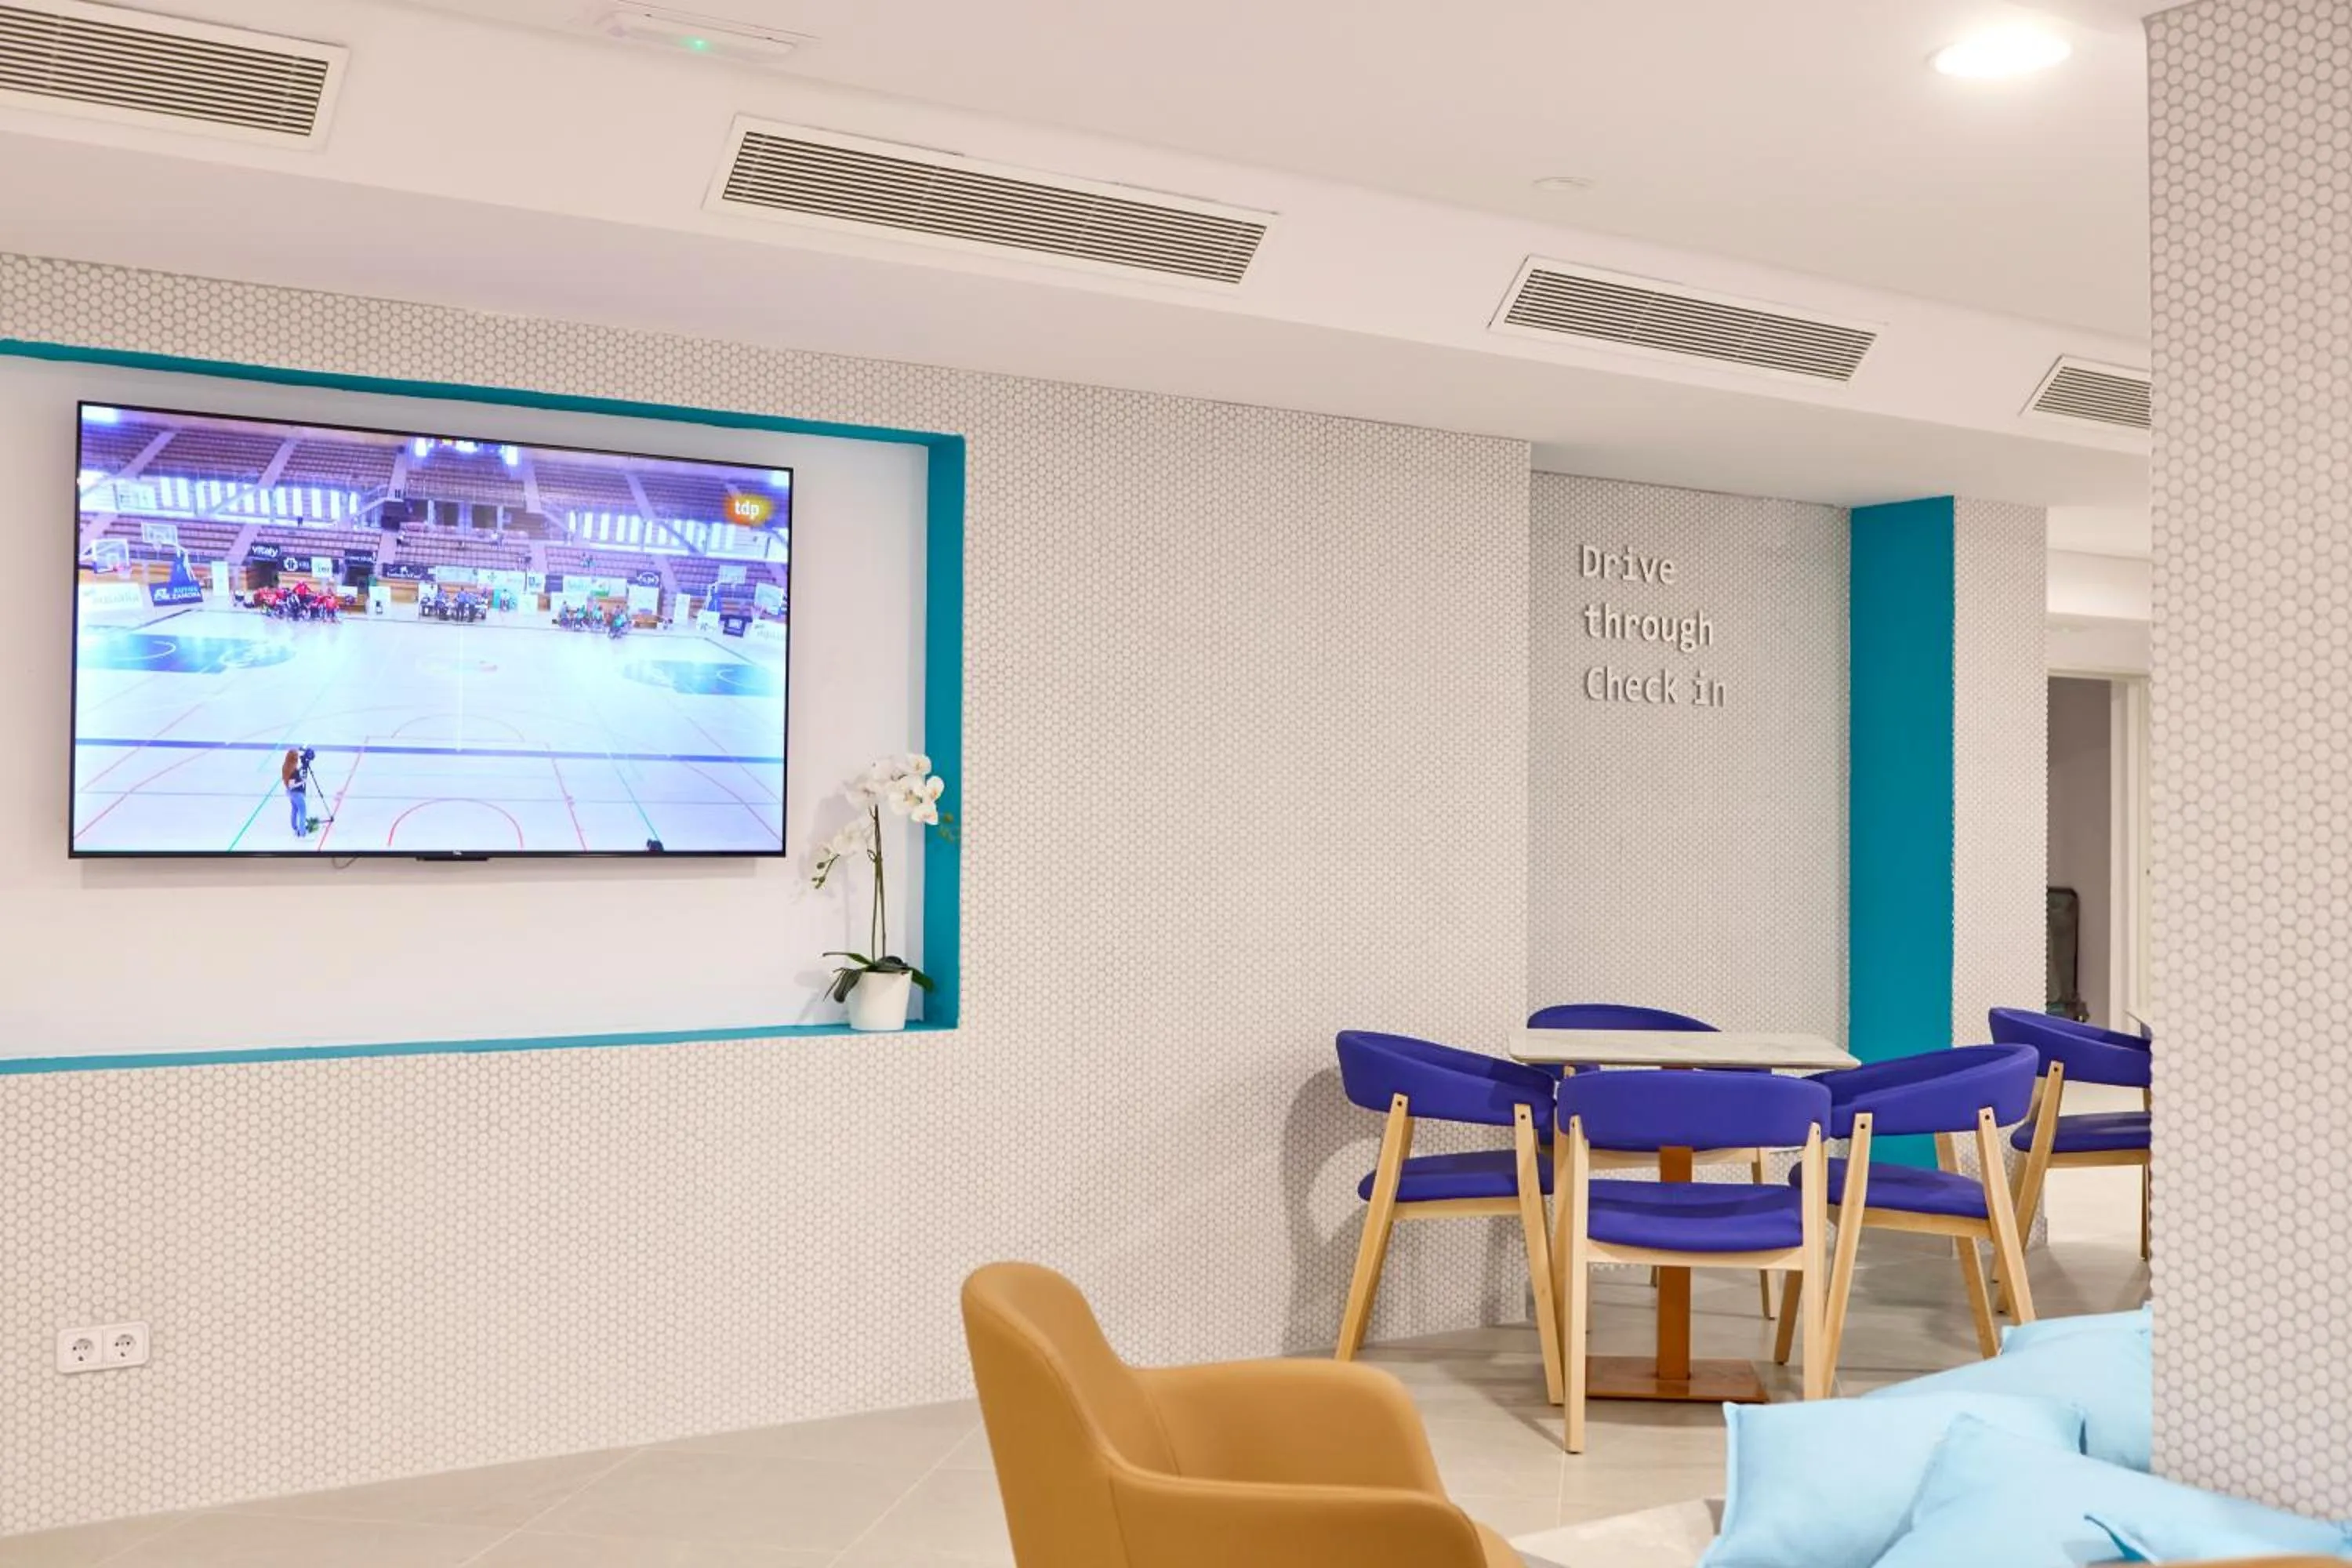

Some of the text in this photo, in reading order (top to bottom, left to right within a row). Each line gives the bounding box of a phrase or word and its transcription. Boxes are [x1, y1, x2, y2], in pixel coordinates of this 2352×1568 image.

[735, 499, 760, 521] tdp
[1581, 544, 1676, 584] Drive
[1584, 603, 1714, 652] through
[1586, 666, 1726, 706] Check in
